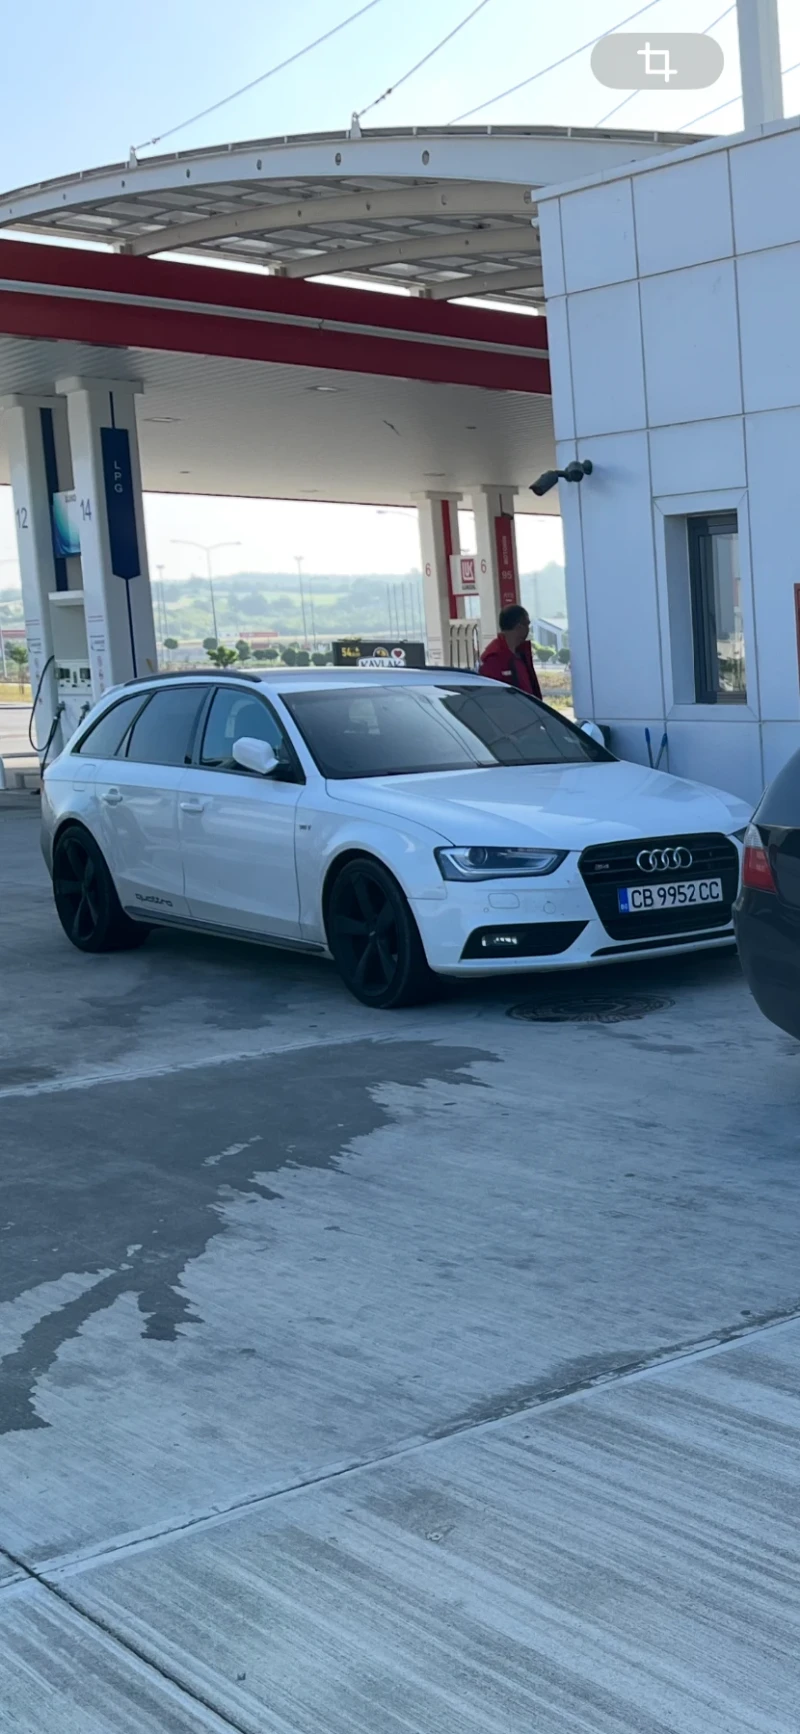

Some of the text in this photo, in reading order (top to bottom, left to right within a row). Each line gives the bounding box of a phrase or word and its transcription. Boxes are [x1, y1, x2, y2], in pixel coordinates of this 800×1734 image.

[114, 461, 123, 492] LPG
[16, 507, 29, 529] 12
[80, 498, 92, 521] 14
[425, 562, 432, 577] 6
[480, 559, 487, 574] 6
[502, 570, 513, 580] 95
[134, 893, 174, 908] quattro
[631, 881, 719, 908] CB 9952 CC
